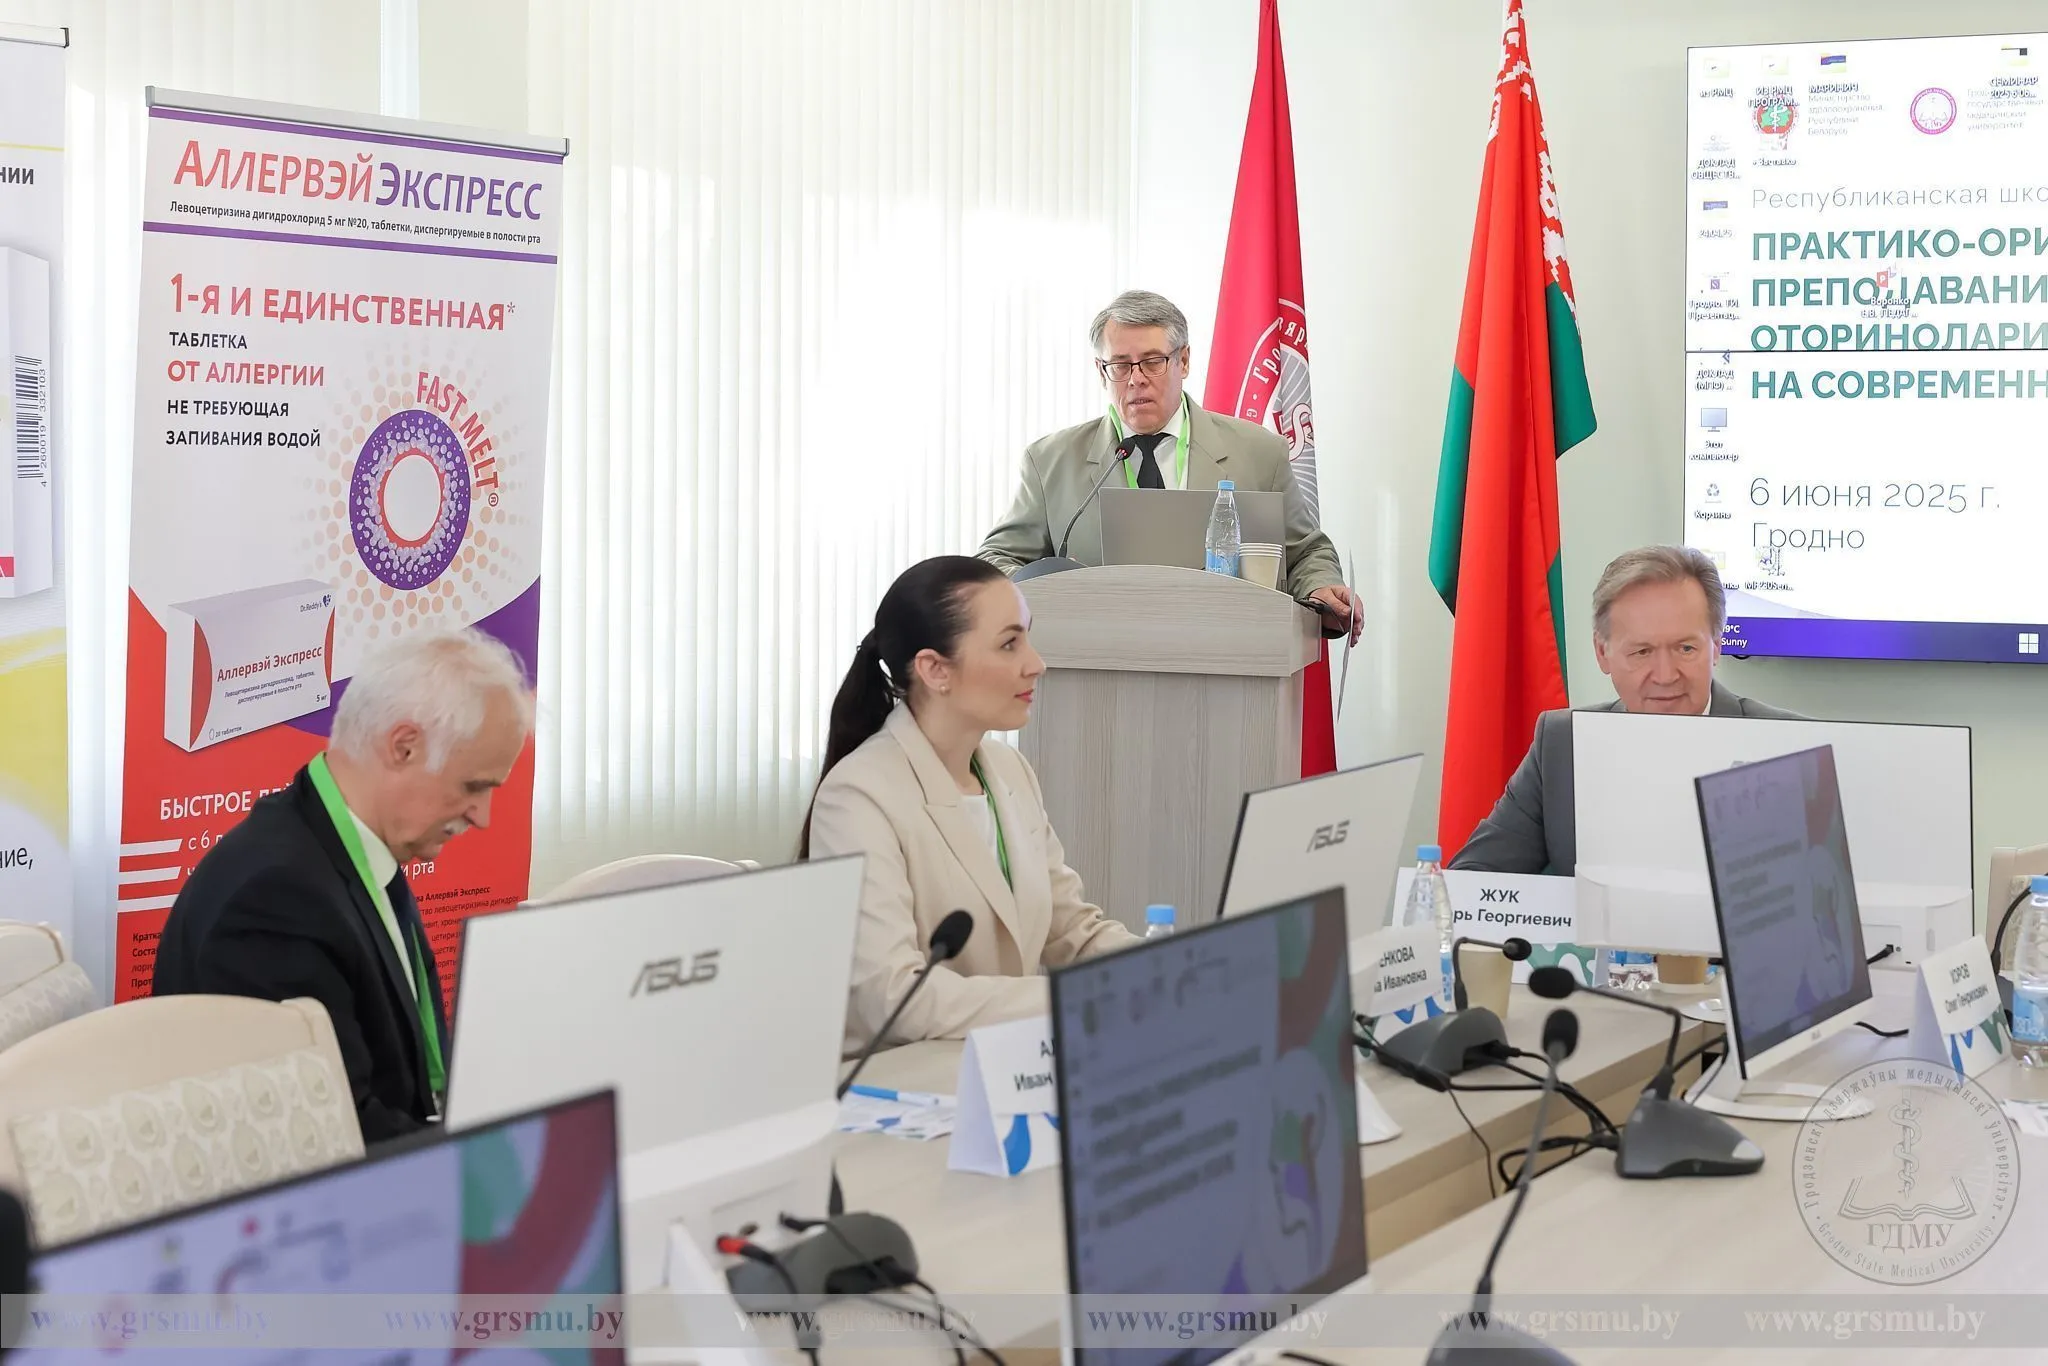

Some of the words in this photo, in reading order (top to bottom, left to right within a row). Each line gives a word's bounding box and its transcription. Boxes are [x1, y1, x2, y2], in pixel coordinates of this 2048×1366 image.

[1752, 184, 1988, 212] Республиканская
[170, 201, 251, 219] Левоцетиризина
[252, 211, 326, 226] дигидрохлорид
[327, 216, 333, 226] 5
[334, 219, 347, 227] мг
[371, 220, 413, 234] таблетки,
[414, 225, 485, 240] диспергируемые
[493, 233, 526, 243] полости
[527, 235, 541, 245] рта
[1752, 228, 2048, 260] ПРАКТИКО-ОРИ
[169, 331, 248, 350] ТАБЛЕТКА
[167, 360, 200, 382] ОТ
[205, 362, 325, 387] АЛЛЕРГИИ
[1752, 370, 1803, 399] НА
[1811, 369, 2048, 400] СОВРЕМЕНН
[167, 399, 189, 415] НЕ
[194, 400, 290, 418] ТРЕБУЮЩАЯ
[416, 371, 467, 421] FAST
[165, 430, 263, 447] ЗАПИВАНИЯ
[267, 429, 321, 448] ВОДОЙ
[1750, 477, 1770, 506] 6
[1782, 484, 1871, 508] июня
[1884, 482, 1968, 514] 2025
[1981, 486, 2000, 508] г.
[1753, 521, 1865, 564] Гродно
[1721, 637, 1748, 648] Sunny
[217, 656, 271, 683] Аллервэй
[273, 646, 322, 668] Экспресс
[159, 790, 252, 820] БЫСТРОЕ
[200, 830, 210, 849] 6
[412, 861, 435, 881] рта
[425, 888, 459, 901] Аллервэй
[460, 886, 491, 897] Экспресс
[1480, 888, 1520, 904] ЖУК
[1477, 908, 1572, 927] Георгиевич
[630, 949, 722, 999] ASUS
